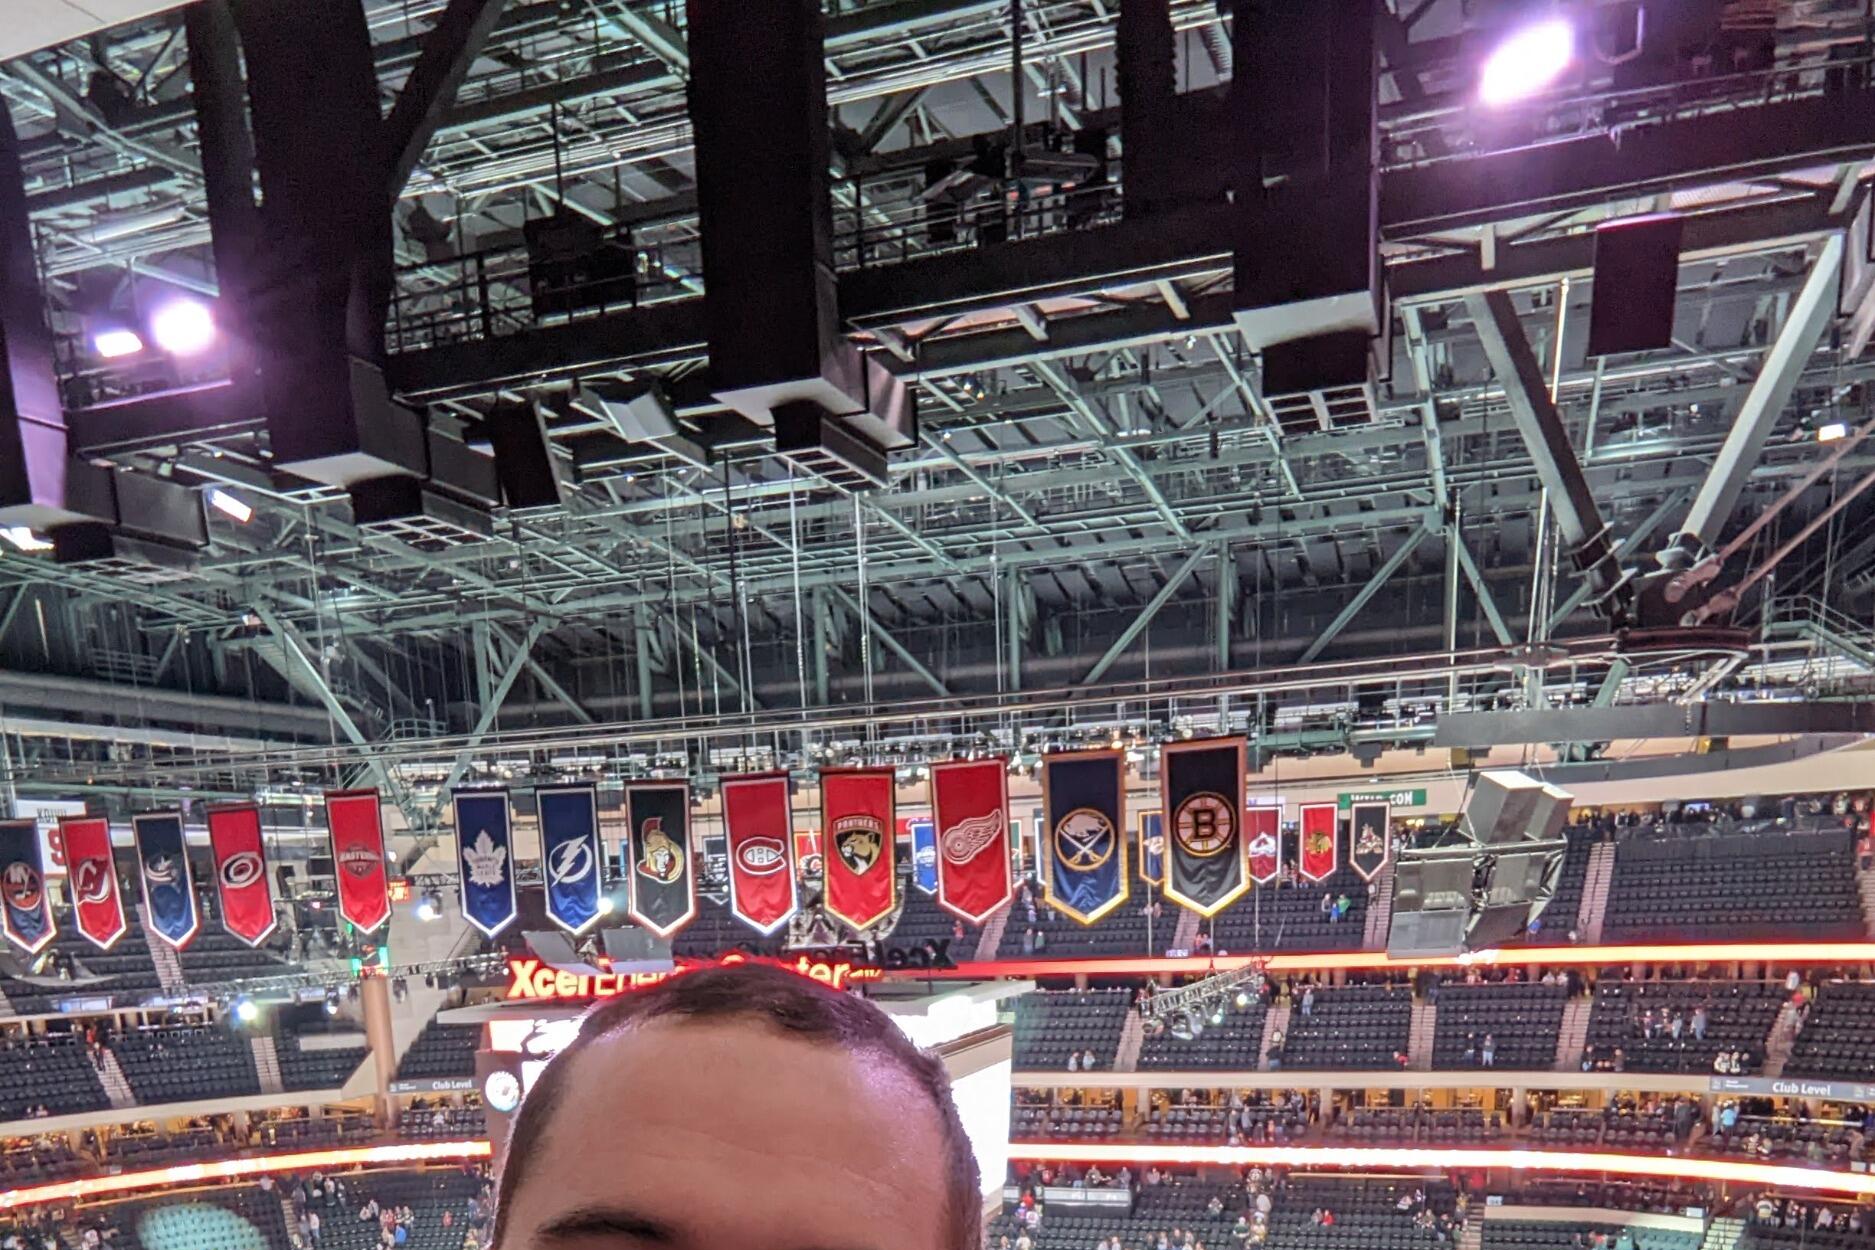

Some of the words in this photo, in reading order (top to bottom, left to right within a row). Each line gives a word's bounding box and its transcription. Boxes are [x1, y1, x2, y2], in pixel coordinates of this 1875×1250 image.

[837, 820, 880, 830] PANTHERS
[1193, 809, 1217, 840] B
[432, 1081, 451, 1090] Club
[452, 1080, 472, 1089] Level
[1772, 1082, 1799, 1093] Club
[1801, 1083, 1831, 1096] Level
